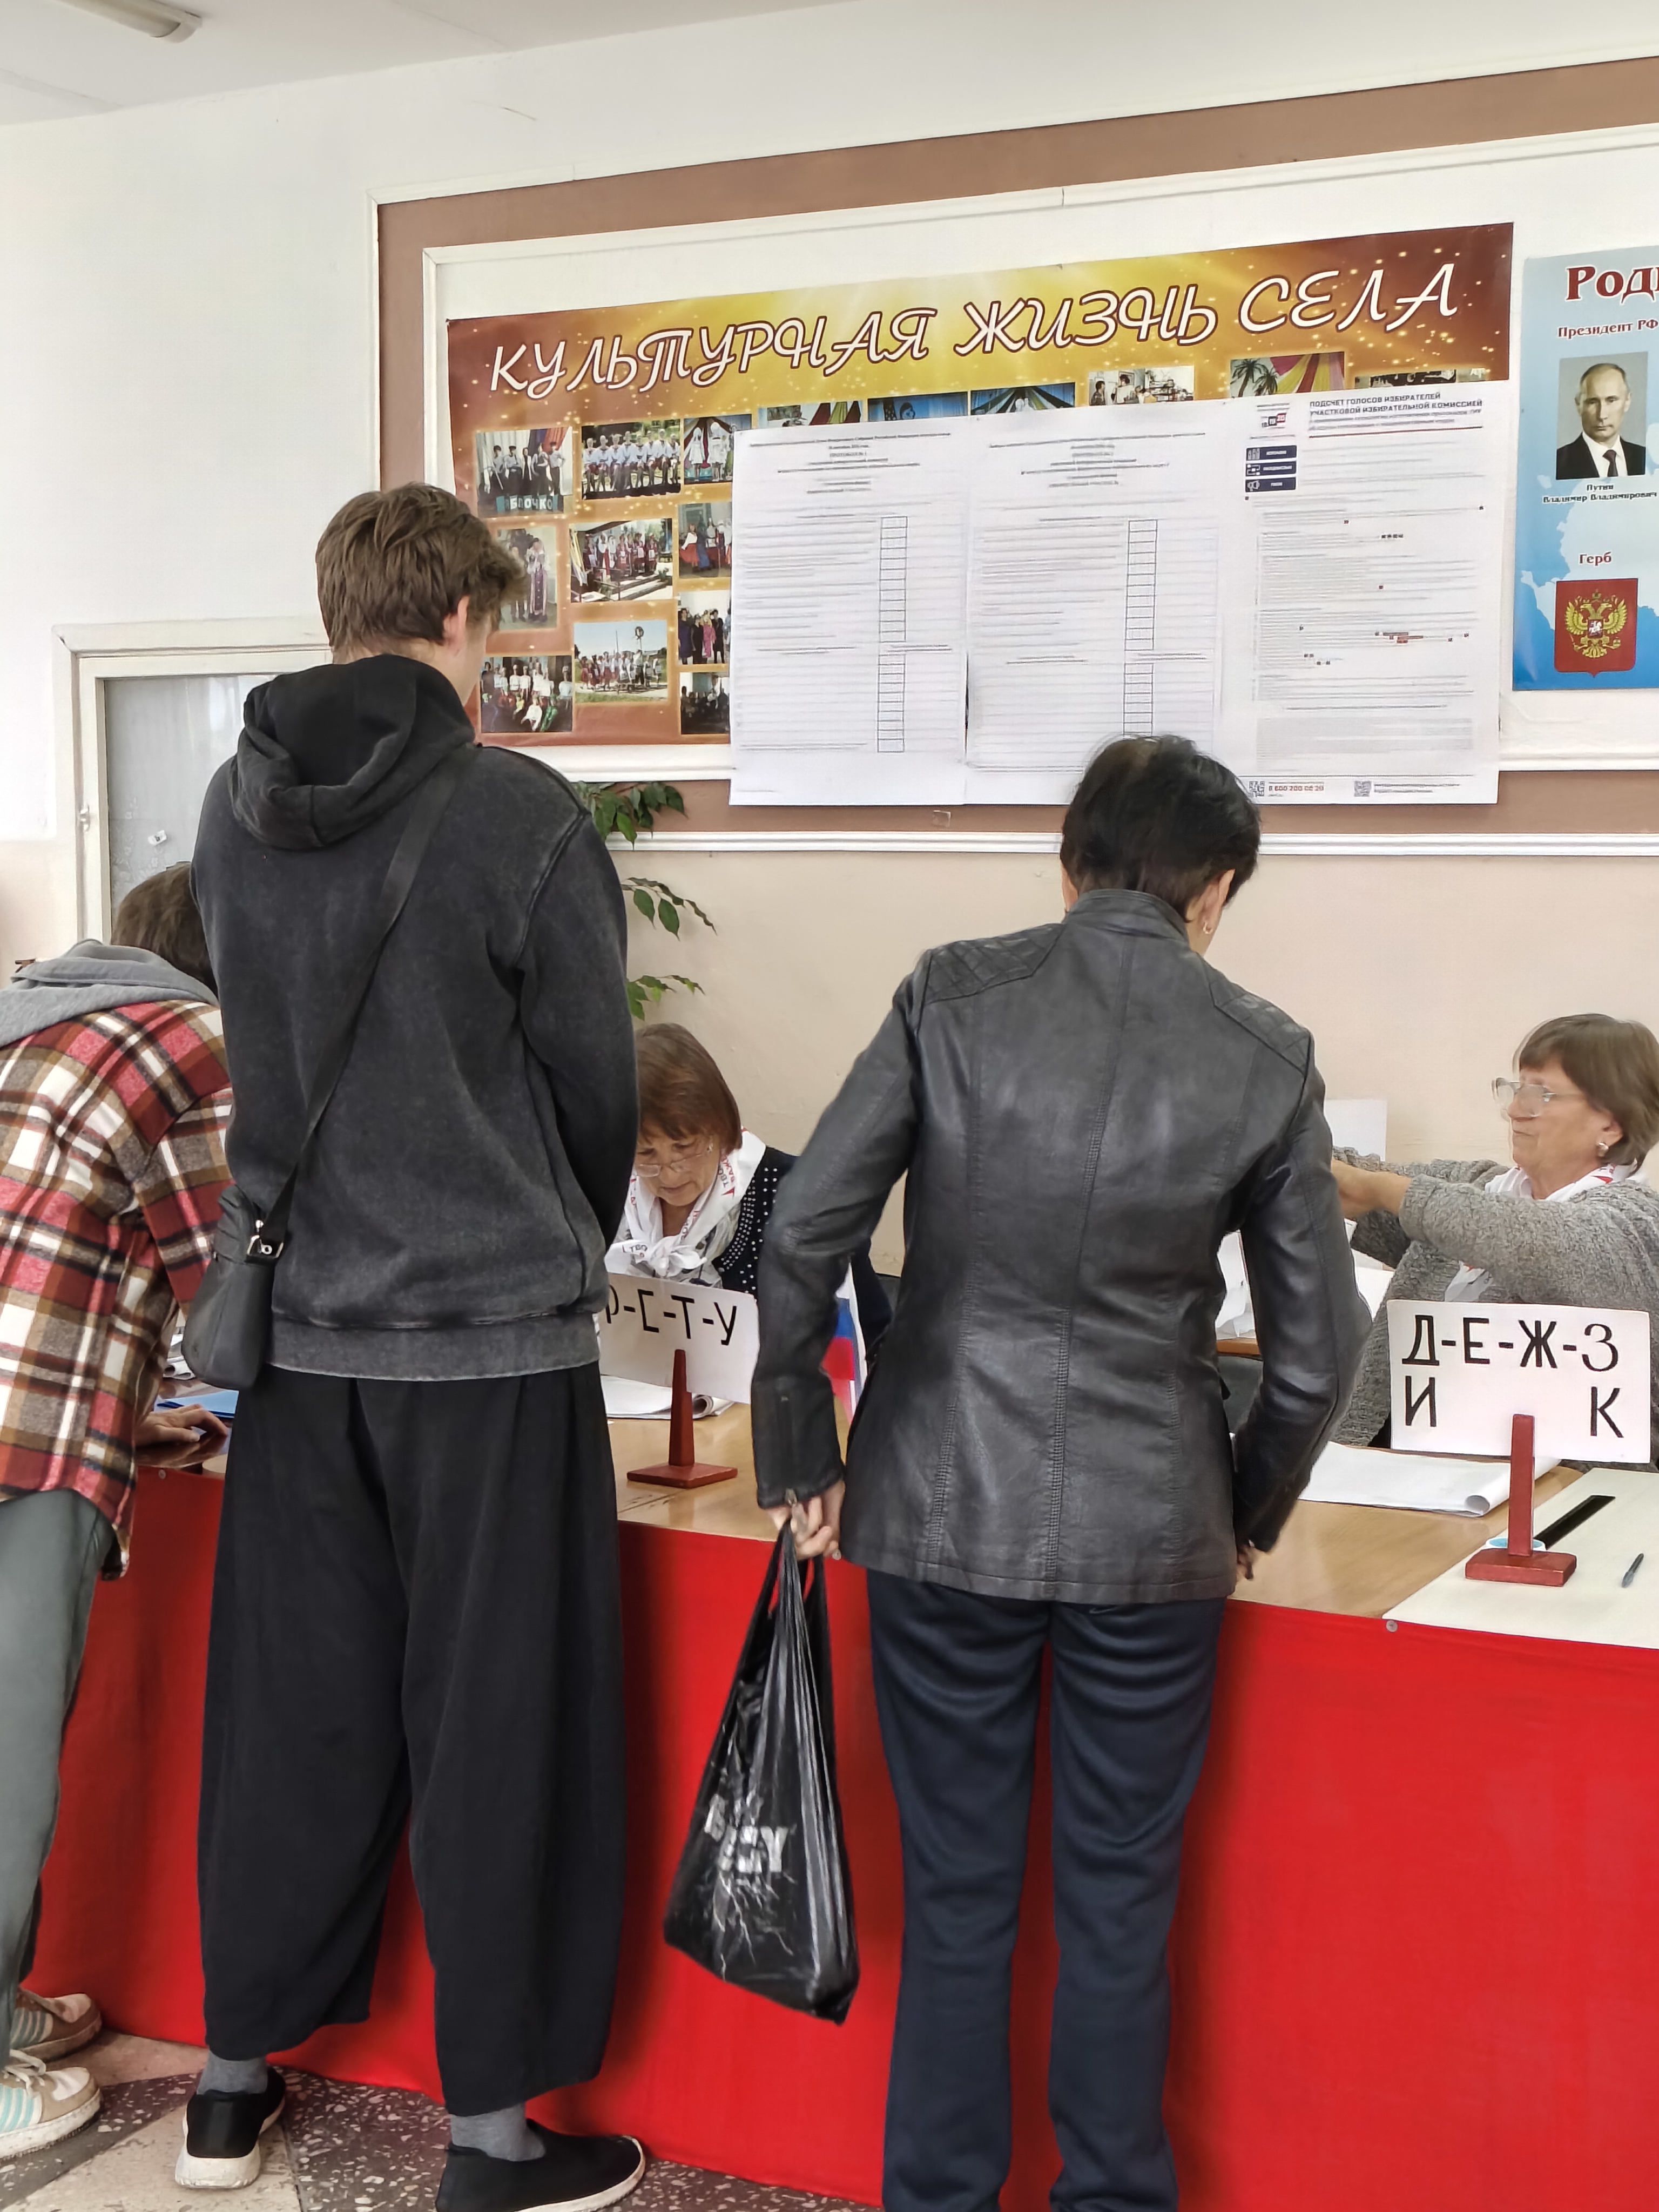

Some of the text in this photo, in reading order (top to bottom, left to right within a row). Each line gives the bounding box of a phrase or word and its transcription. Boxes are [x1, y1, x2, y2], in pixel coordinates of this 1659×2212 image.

[1566, 266, 1659, 304] Род
[489, 262, 1459, 400] КУЛЬТУРНАЯ ЖИЗНЬ СЕЛА
[1558, 319, 1658, 339] Президент РФ
[1579, 551, 1612, 566] Герб
[1402, 1314, 1618, 1372] Д-Е-Ж-З
[1405, 1375, 1624, 1438] И К
